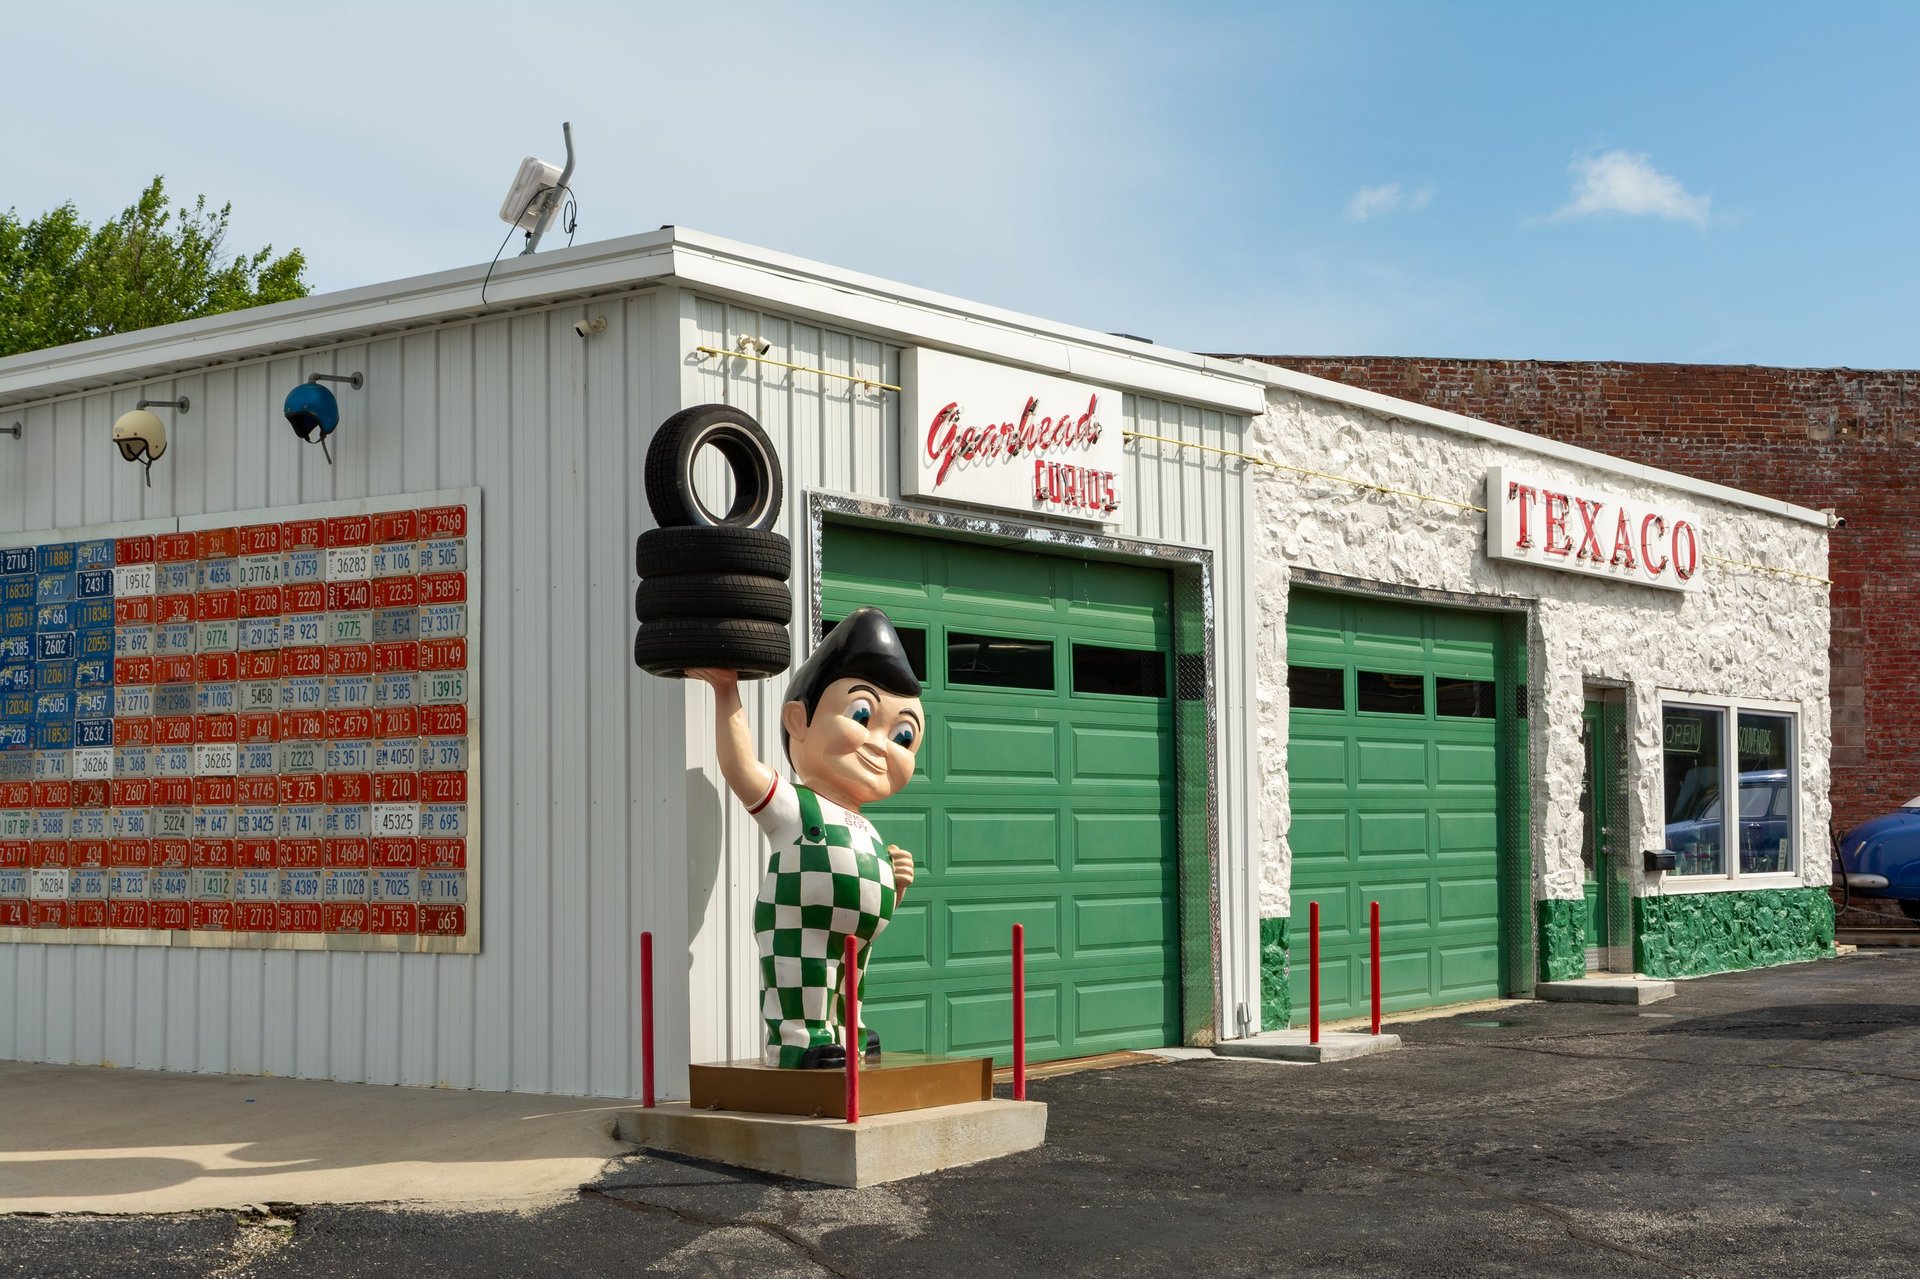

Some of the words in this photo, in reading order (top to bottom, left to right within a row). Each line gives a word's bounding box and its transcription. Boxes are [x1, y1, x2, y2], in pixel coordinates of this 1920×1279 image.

[926, 393, 1101, 486] Gearhead
[1034, 459, 1116, 512] CURIOS
[393, 520, 410, 536] 157
[436, 514, 461, 532] 2968
[1507, 481, 1697, 580] TEXACO
[255, 531, 276, 548] 2218
[301, 528, 318, 544] 875
[343, 523, 366, 540] 2207
[87, 546, 107, 563] 2124
[130, 542, 150, 559] 1510
[174, 540, 189, 556] 132
[6, 554, 27, 570] 2710
[337, 556, 366, 573] 36283
[392, 553, 410, 569] 106
[439, 549, 457, 565] 505
[210, 567, 230, 584] 4656
[249, 565, 270, 582] 3776
[294, 560, 318, 577] 6759
[53, 580, 63, 595] 21
[86, 577, 104, 593] 2431
[125, 574, 150, 590] 19512
[172, 572, 188, 588] 591
[343, 587, 366, 605] 5440
[389, 584, 414, 601] 2235
[435, 580, 460, 597] 5859
[212, 598, 228, 614] 517
[254, 594, 277, 611] 2208
[298, 590, 321, 607] 2220
[133, 603, 148, 618] 100
[172, 600, 189, 616] 326
[53, 609, 68, 624] 661
[436, 614, 460, 631] 3317
[300, 624, 317, 639] 923
[337, 620, 360, 638] 9775
[392, 618, 410, 634] 454
[131, 635, 147, 651] 692
[172, 633, 188, 649] 428
[206, 630, 227, 646] 9774
[251, 628, 278, 644] 29135
[45, 639, 66, 655] 2602
[437, 646, 461, 663] 1149
[254, 656, 275, 674] 2507
[297, 654, 320, 670] 2238
[344, 652, 367, 669] 7379
[387, 650, 403, 666] 311
[90, 666, 104, 682] 574
[129, 663, 149, 679] 2125
[170, 662, 191, 677] 1062
[217, 659, 228, 676] 15
[14, 671, 29, 685] 445
[252, 688, 272, 704] 5458
[298, 686, 320, 702] 1639
[344, 686, 367, 702] 1017
[393, 683, 410, 700] 585
[432, 680, 461, 697] 13915
[49, 698, 68, 713] 6051
[86, 696, 106, 711] 3457
[128, 695, 149, 711] 2710
[212, 691, 232, 707] 1083
[6, 700, 29, 715] 12034
[212, 721, 233, 737] 2203
[257, 720, 271, 736] 641
[298, 718, 320, 734] 1286
[343, 716, 367, 733] 4579
[387, 714, 410, 731] 2015
[437, 713, 461, 730] 2205
[11, 729, 26, 743] 228
[83, 726, 104, 742] 2632
[129, 725, 149, 740] 1362
[168, 722, 190, 739] 2608
[1664, 724, 1698, 744] OPEN
[130, 756, 146, 771] 368
[170, 754, 187, 769] 638
[205, 753, 231, 769] 36265
[250, 752, 272, 769] 2883
[290, 751, 314, 767] 2223
[343, 750, 366, 766] 3511
[390, 748, 414, 765] 4050
[440, 748, 459, 764] 379
[51, 759, 64, 774] 741
[82, 757, 108, 772] 36266
[9, 787, 29, 804] 2605
[47, 786, 68, 803] 2603
[88, 786, 104, 802] 296
[126, 784, 147, 801] 2607
[167, 784, 186, 800] 1101
[210, 784, 231, 799] 2210
[252, 783, 274, 798] 4745
[299, 782, 315, 798] 275
[342, 780, 360, 797] 356
[392, 779, 410, 796] 210
[437, 780, 461, 796] 2213
[43, 819, 63, 833] 5688
[88, 818, 103, 833] 595
[128, 817, 144, 832] 580
[164, 816, 185, 831] 5224
[211, 816, 227, 831] 647
[252, 816, 274, 832] 3425
[296, 815, 311, 831] 741
[344, 814, 360, 830] 851
[383, 814, 413, 830] 45325
[440, 814, 458, 830] 695
[844, 817, 867, 832] BOY
[44, 846, 65, 862] 2416
[86, 846, 102, 862] 434
[126, 846, 146, 861] 1189
[165, 845, 186, 861] 5020
[210, 846, 227, 861] 623
[254, 846, 270, 861] 406
[296, 846, 317, 862] 1375
[336, 844, 364, 862] 14684
[435, 846, 460, 863] 9047
[40, 878, 64, 893] 36284
[86, 878, 102, 892] 656
[127, 878, 143, 893] 233
[165, 878, 186, 894] 4649
[203, 878, 229, 893] 14312
[250, 879, 267, 895] 514
[294, 879, 318, 895] 4389
[342, 879, 365, 895] 1028
[385, 880, 410, 895] 7025
[440, 880, 458, 896] 116
[47, 907, 60, 922] 739
[84, 906, 102, 922] 1236
[123, 906, 144, 923] 2712
[164, 908, 185, 924] 2201
[208, 909, 229, 924] 1822
[250, 908, 272, 926] 2713
[294, 909, 317, 926] 8170
[340, 909, 364, 927] 4649
[391, 911, 409, 927] 153
[438, 912, 457, 929] 665
